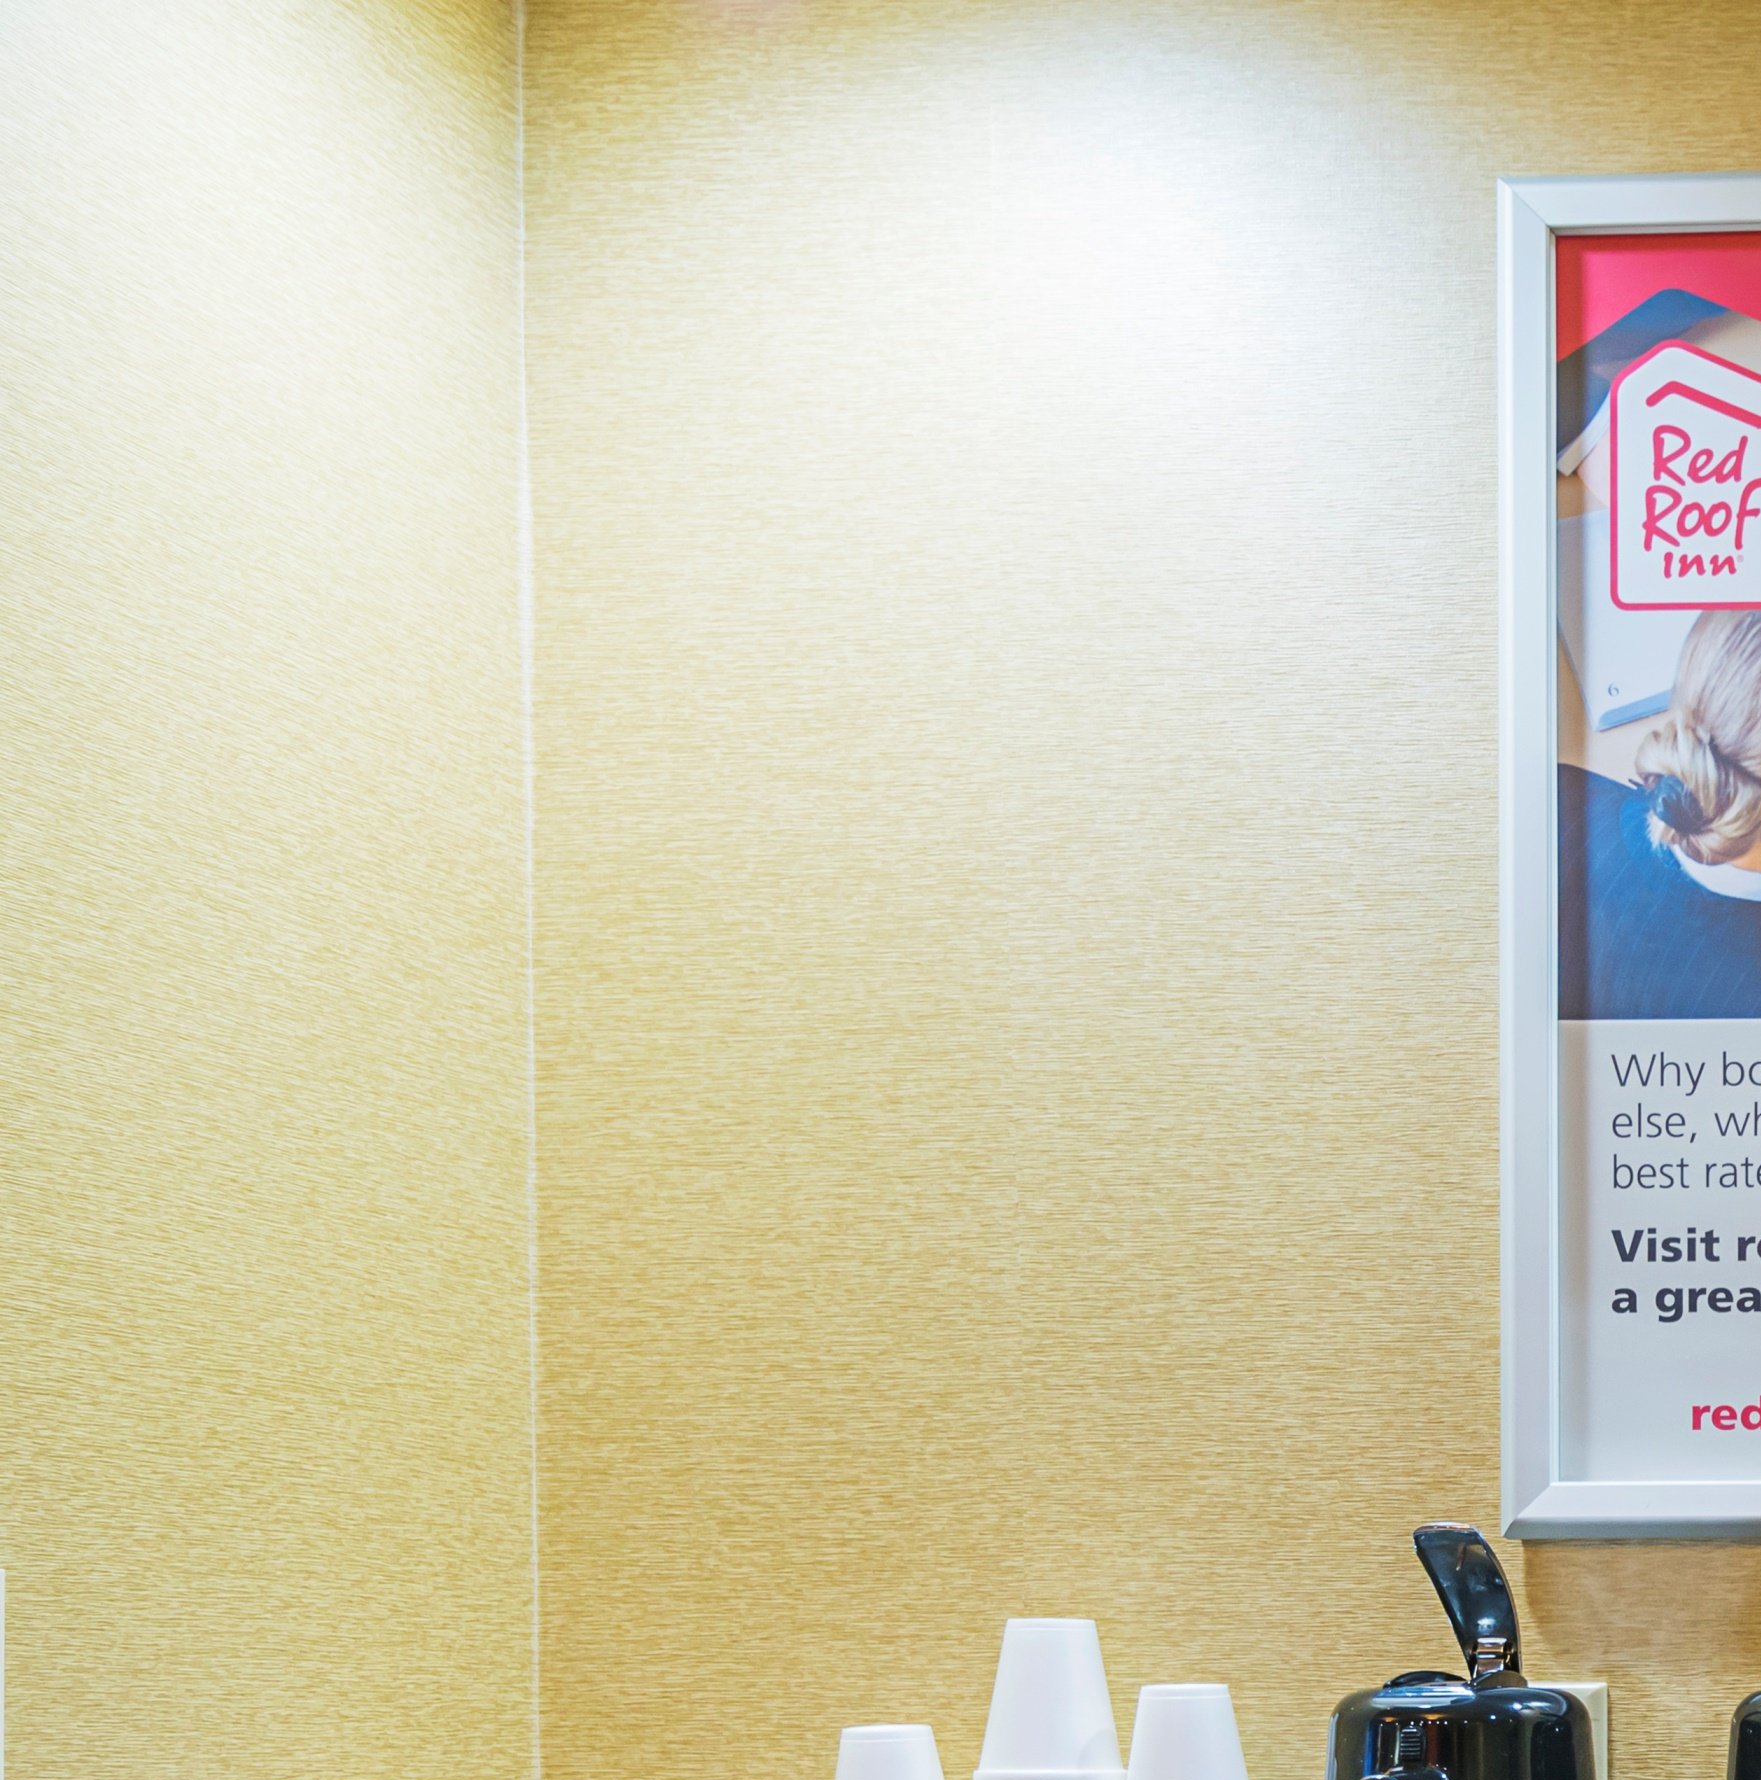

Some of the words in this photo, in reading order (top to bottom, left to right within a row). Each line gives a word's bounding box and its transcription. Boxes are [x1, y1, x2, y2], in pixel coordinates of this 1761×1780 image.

[1651, 424, 1749, 486] Red
[1611, 1052, 1706, 1097] Why
[1612, 1101, 1697, 1144] else,
[1613, 1153, 1690, 1190] best
[1610, 1227, 1721, 1263] Visit
[1611, 1287, 1638, 1314] a
